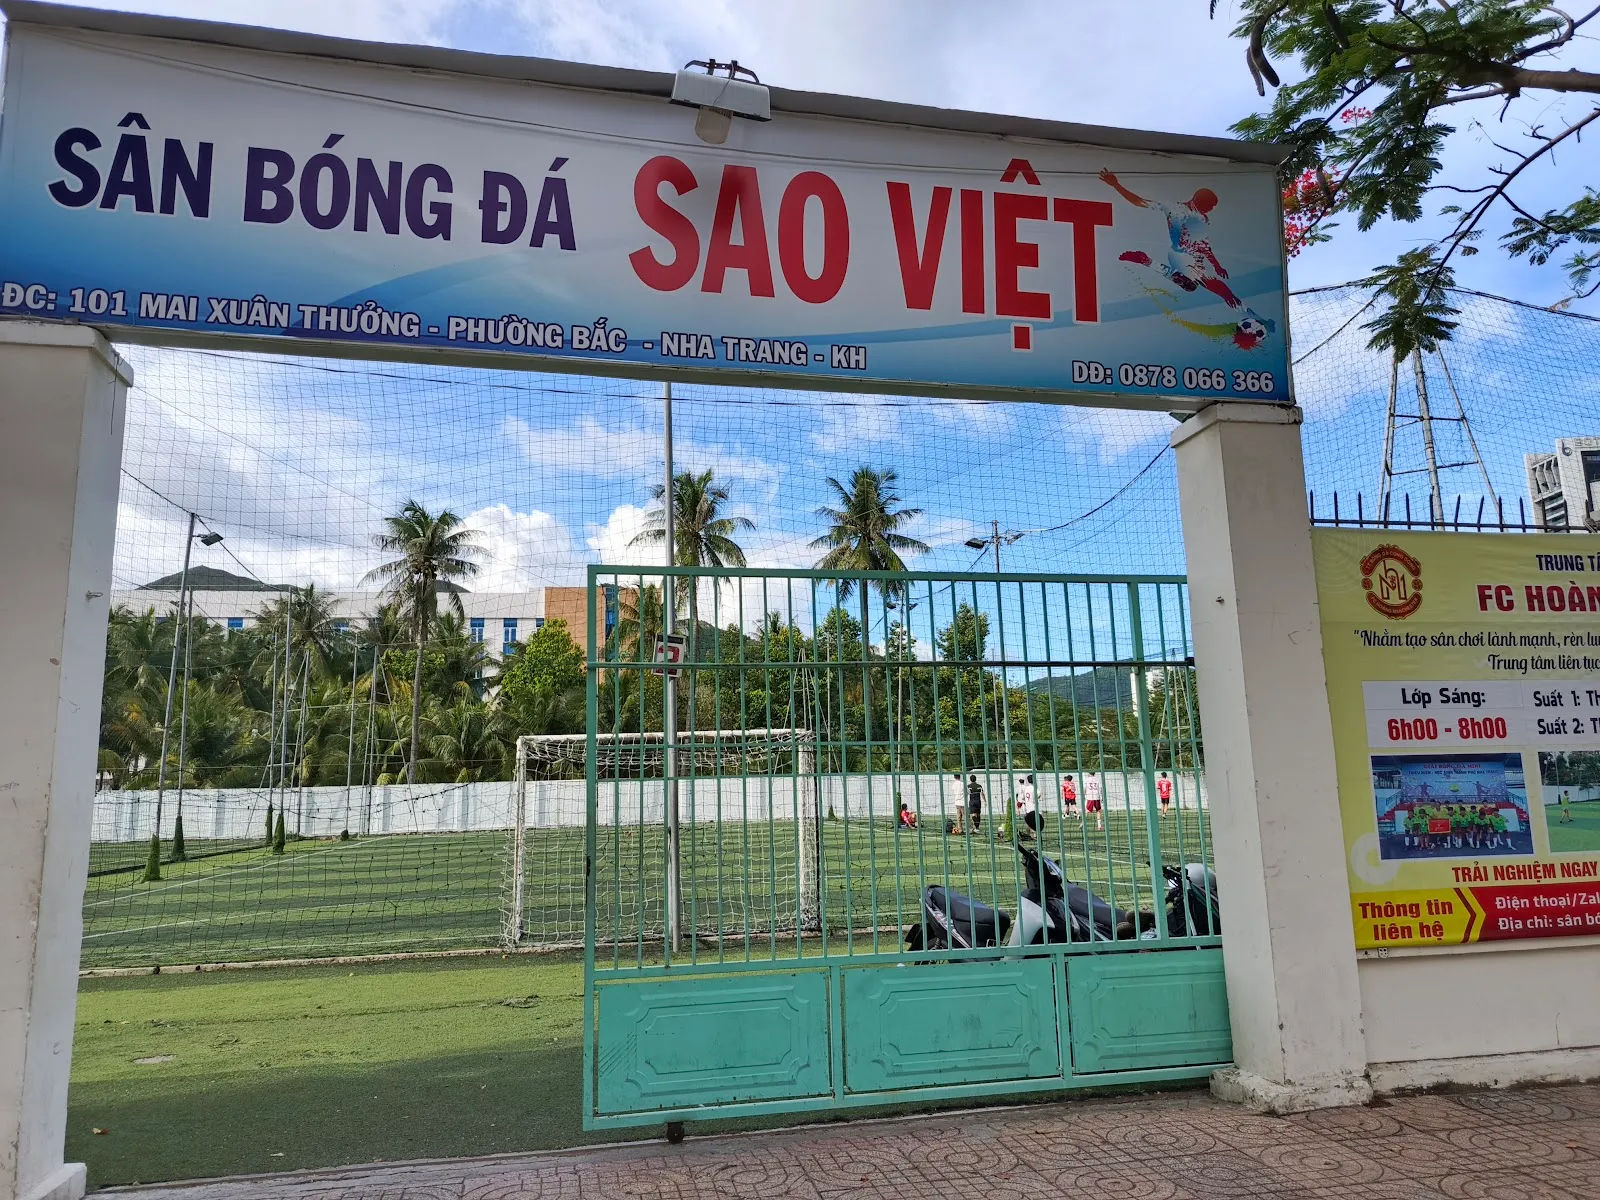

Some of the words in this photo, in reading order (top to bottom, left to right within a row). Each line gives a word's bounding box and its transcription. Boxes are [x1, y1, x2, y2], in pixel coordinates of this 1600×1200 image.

[48, 112, 213, 218] SÂN
[243, 134, 454, 241] BÓNG
[479, 157, 577, 251] ĐÁ
[629, 155, 850, 304] SAO
[886, 158, 1113, 350] VIỆT
[2, 281, 56, 311] ĐC:
[69, 287, 128, 317] 101
[139, 292, 199, 322] MAI
[207, 294, 290, 328] XUÂN
[299, 301, 420, 338] THƯỞNG
[449, 314, 563, 348] PHƯỜNG
[571, 317, 627, 352] BẮC
[661, 331, 715, 359] NHA
[721, 336, 808, 366] TRANG
[831, 345, 867, 369] KH
[1072, 360, 1113, 384] DĐ:
[1119, 363, 1178, 388] 0878
[1183, 367, 1226, 391] 066
[1232, 370, 1274, 393] 366
[1536, 554, 1584, 572] TRUNG
[1477, 585, 1514, 612] FC
[1524, 580, 1600, 612] HOÀN
[1405, 632, 1427, 649] tạo
[1430, 632, 1456, 647] sân
[1458, 631, 1485, 647] chơi
[1488, 632, 1518, 647] lành
[1519, 631, 1561, 649] mạnh,
[1563, 631, 1585, 647] rèn
[1487, 654, 1528, 675] Trung
[1530, 655, 1556, 670] tâm
[1558, 654, 1582, 670] liên
[1582, 655, 1600, 672] tục
[1401, 688, 1432, 709] Lớp
[1439, 688, 1485, 708] Sáng:
[1533, 689, 1564, 707] Suất
[1571, 690, 1580, 706] 1:
[1387, 718, 1438, 741] 6h00
[1457, 717, 1507, 740] 8h00
[1537, 717, 1568, 735] Suất
[1572, 718, 1585, 734] 2:
[1590, 717, 1600, 734] T
[1452, 861, 1488, 883] TRẢI
[1493, 860, 1557, 883] NGHIỆM
[1560, 861, 1598, 878] NGAY
[1358, 901, 1421, 919] Thông
[1426, 899, 1453, 916] tin
[1495, 896, 1530, 911] Điện
[1373, 923, 1413, 941] liên
[1419, 921, 1444, 941] hệ
[1498, 916, 1523, 932] Địa
[1557, 914, 1582, 928] sân
